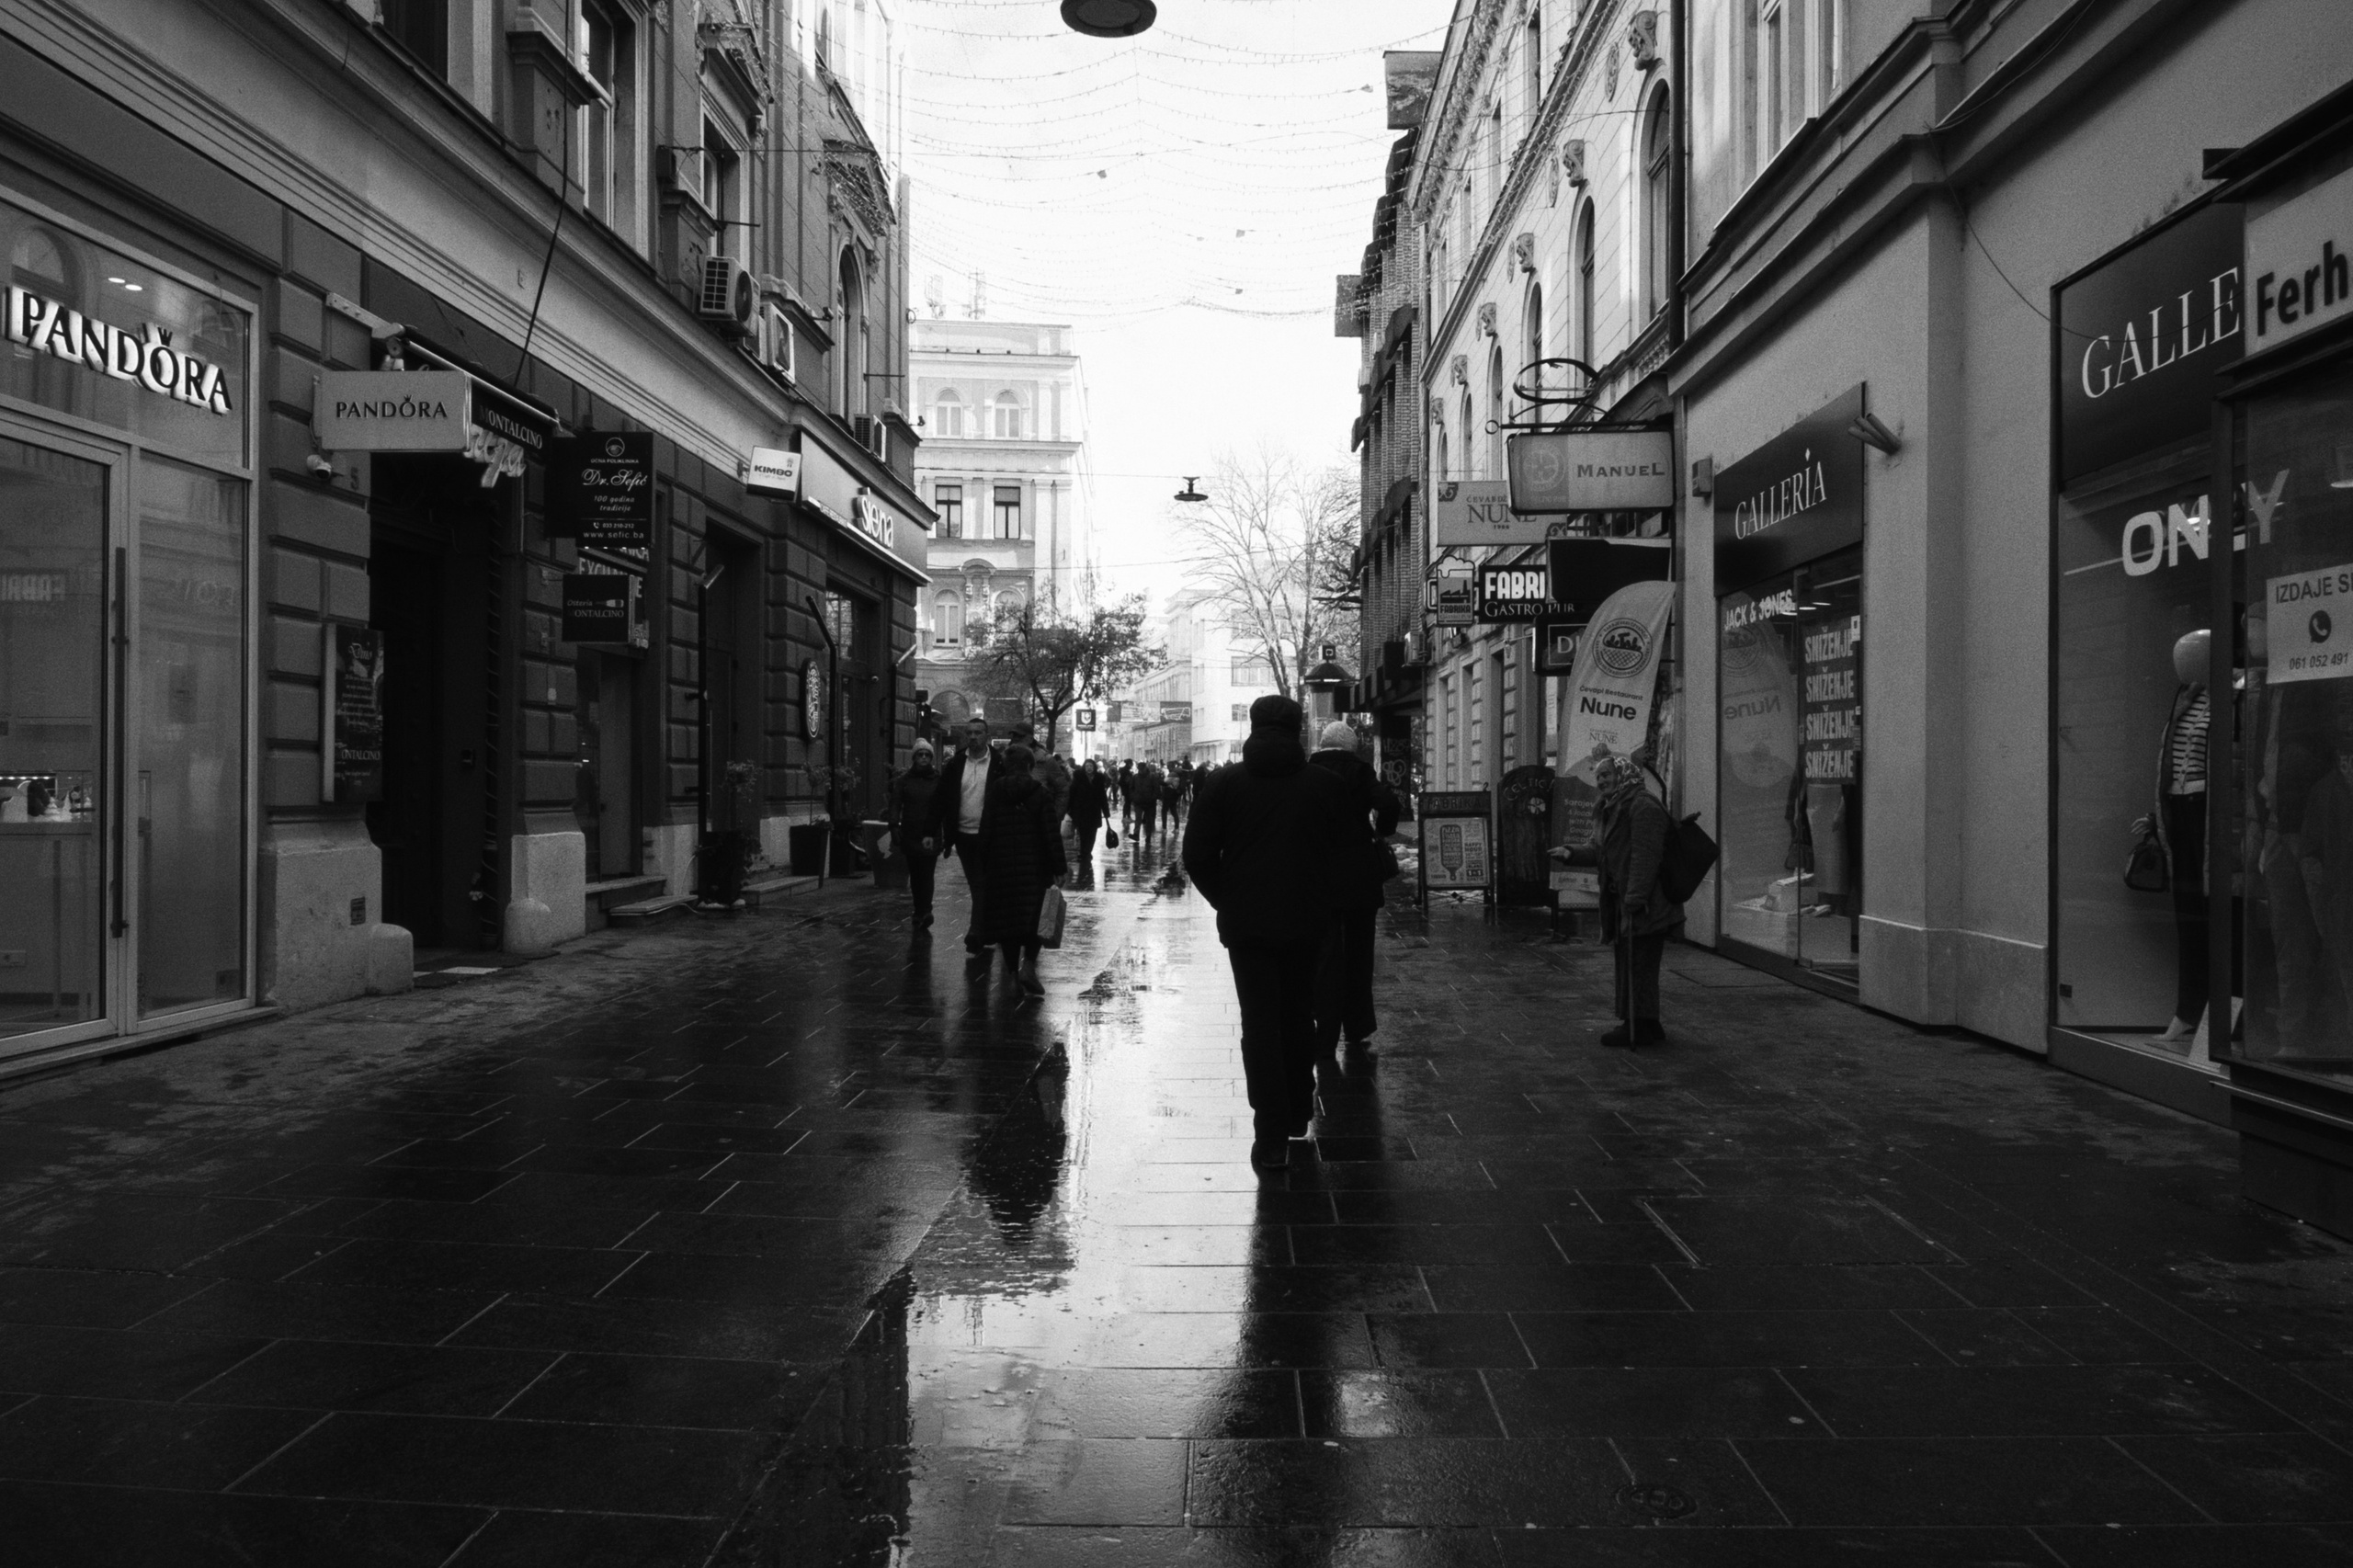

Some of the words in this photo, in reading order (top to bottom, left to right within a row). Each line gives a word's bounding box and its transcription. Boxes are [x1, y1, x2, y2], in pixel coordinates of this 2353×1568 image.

[2256, 241, 2348, 336] Ferh
[2082, 267, 2240, 398] GALLE
[336, 395, 448, 418] PANDORA
[755, 465, 793, 477] KIMBO
[599, 505, 631, 513] tradicije
[609, 495, 635, 505] godina
[1734, 452, 1826, 540] GALLERIA
[860, 486, 893, 549] siena
[2122, 469, 2290, 576] ONY
[1484, 571, 1546, 599] FABRI
[2276, 576, 2333, 604] IZDAJE
[1440, 605, 1471, 613] FABRIKA
[1484, 602, 1543, 618] GASTRO
[1724, 604, 1747, 631] JACK
[1749, 601, 1756, 623] &
[1758, 588, 1793, 620] JONES
[1805, 626, 1853, 664] SNIŽENJE
[2289, 657, 2306, 670] 061
[2310, 654, 2328, 668] 052
[2331, 652, 2348, 665] 491
[1605, 689, 1643, 701] Restaurant
[1806, 666, 1854, 702] SNIŽENJE
[1580, 697, 1636, 721] Nune
[1807, 705, 1854, 741] SNIŽENJE
[1589, 732, 1618, 744] NUNE
[1806, 744, 1853, 778] SNIŽENJE
